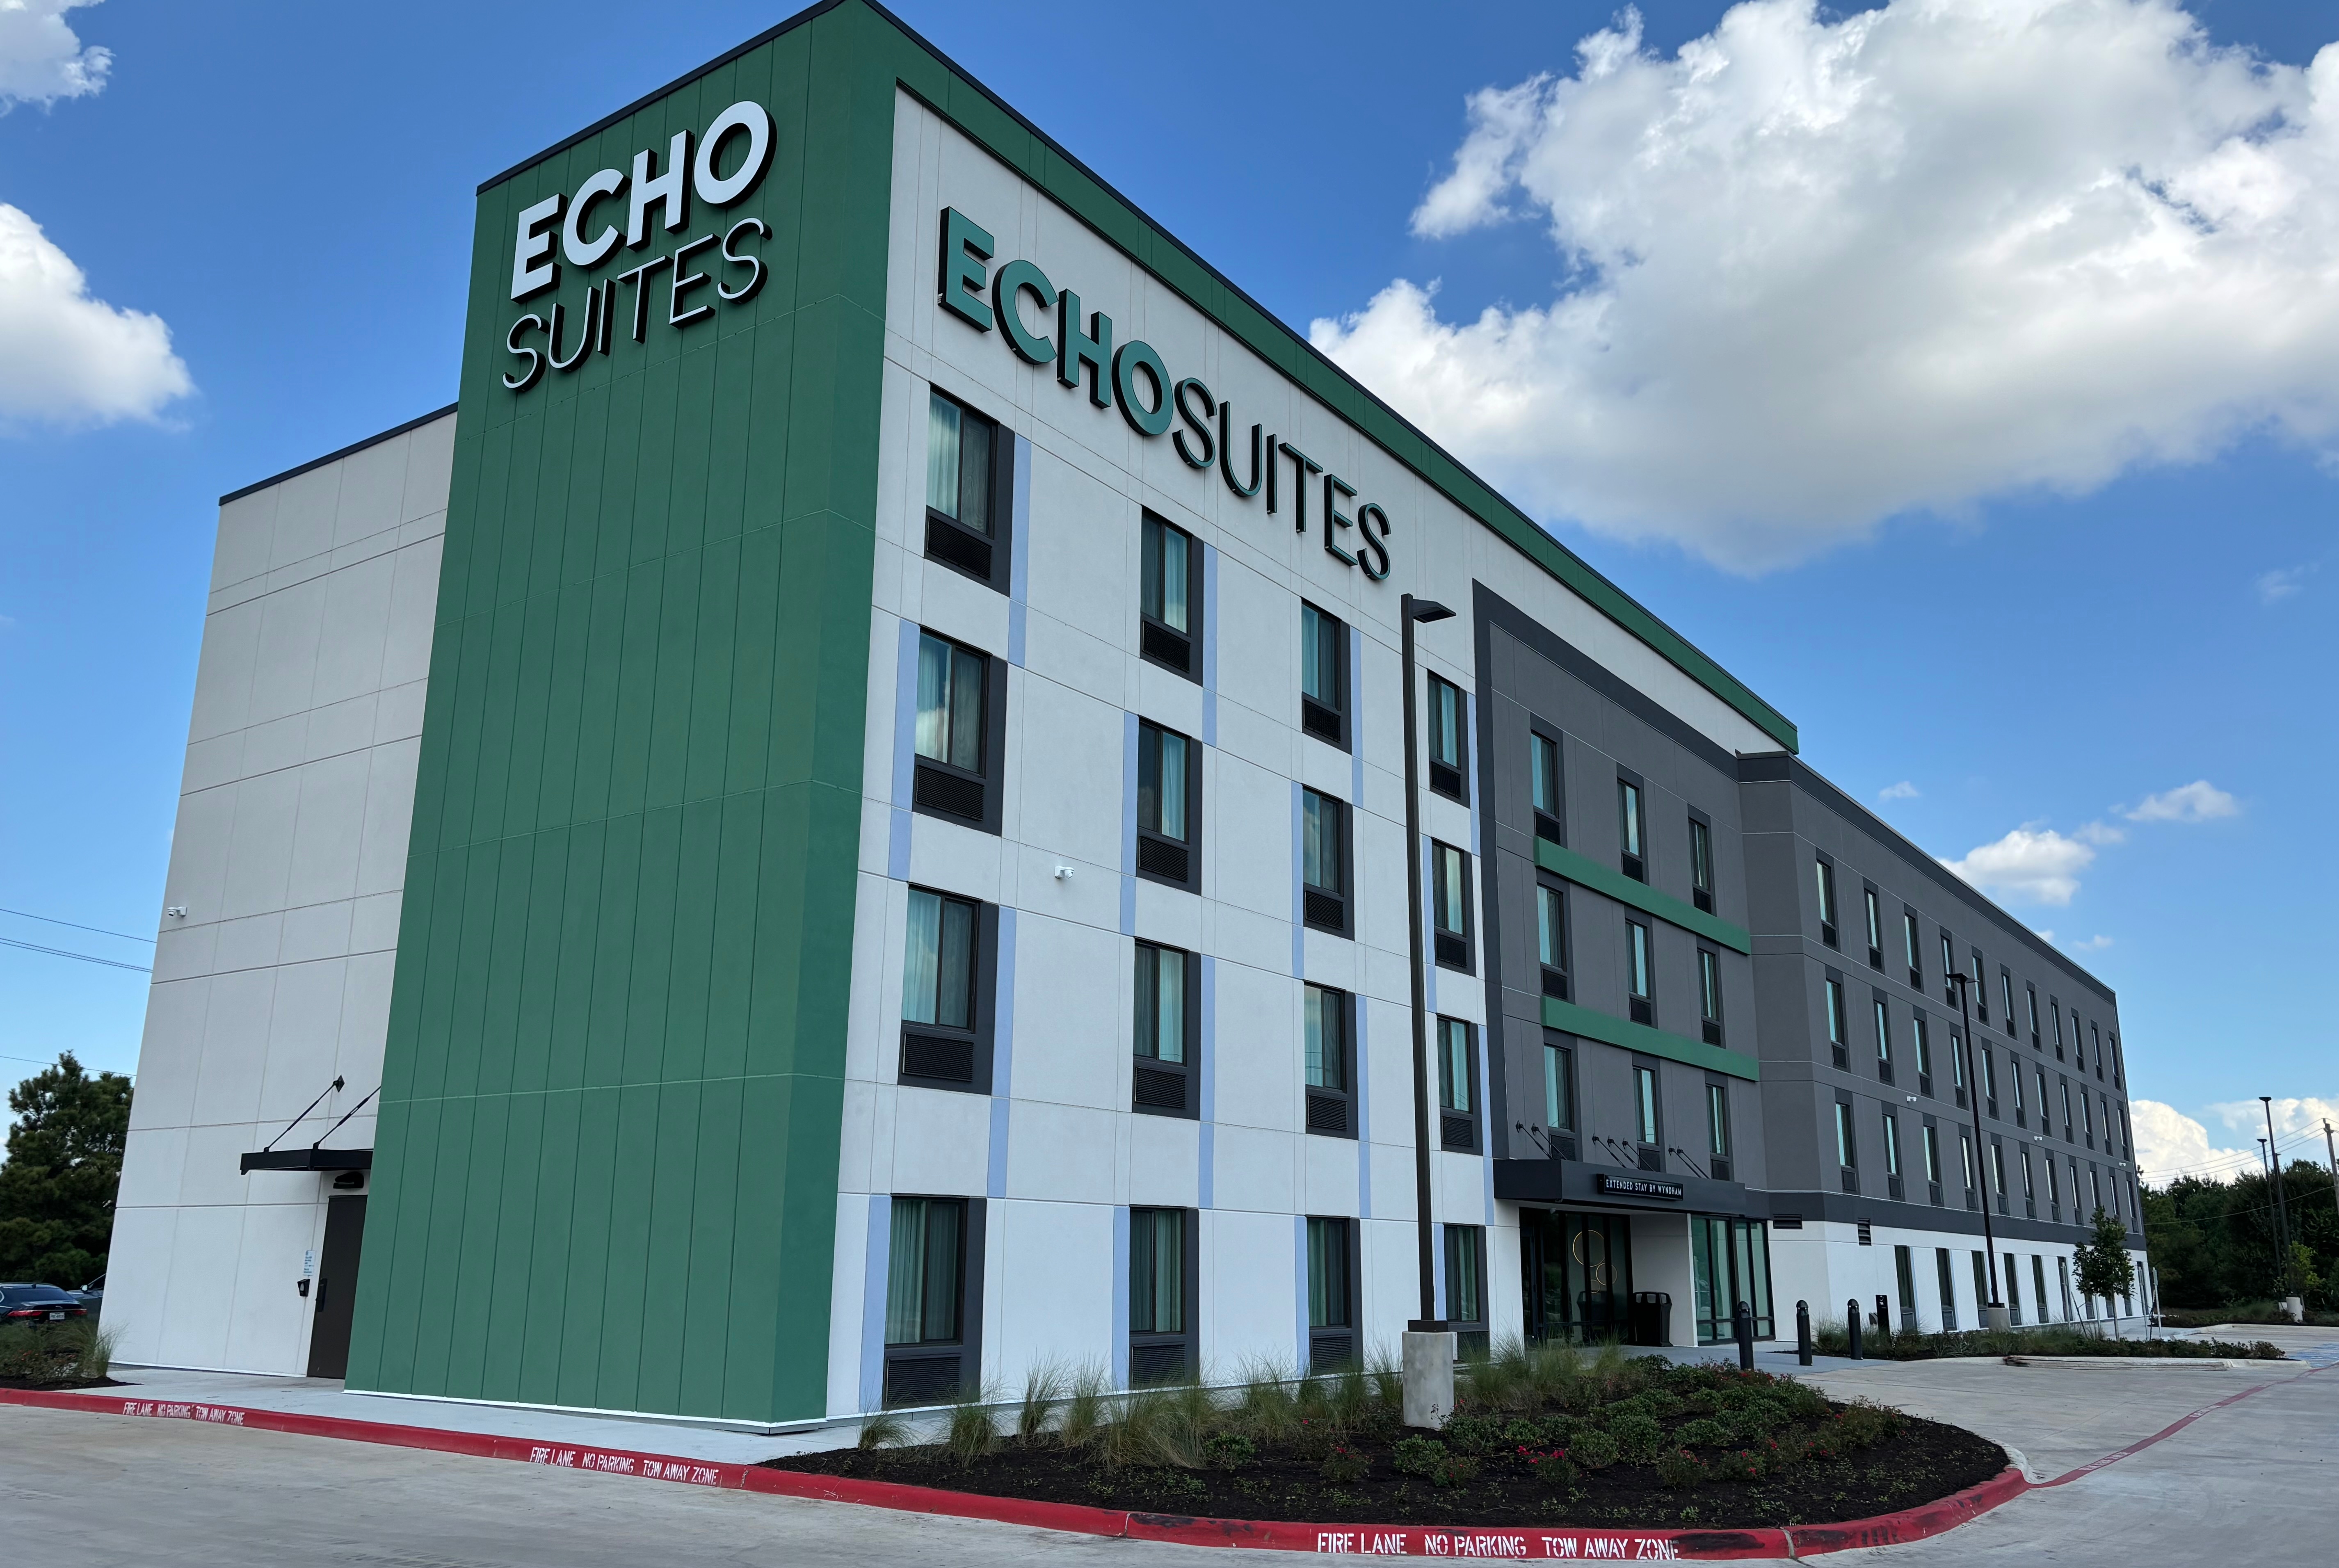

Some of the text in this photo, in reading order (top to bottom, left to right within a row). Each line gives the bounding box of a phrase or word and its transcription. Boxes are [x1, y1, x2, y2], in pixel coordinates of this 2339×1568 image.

[510, 100, 777, 304] ECHO
[503, 217, 772, 392] SUITES
[1606, 1179, 1682, 1196] EXTENDED STAY BY WYNDHAM
[123, 1402, 245, 1425] FIRE LANE NO PARKING TOW AWAY ZONE
[530, 1447, 719, 1485] FIRE LANE NO PARKING TOW AWAY ZONE
[1318, 1533, 1681, 1560] FIRE LANE NO PARKING TOW AWAY ZONE
